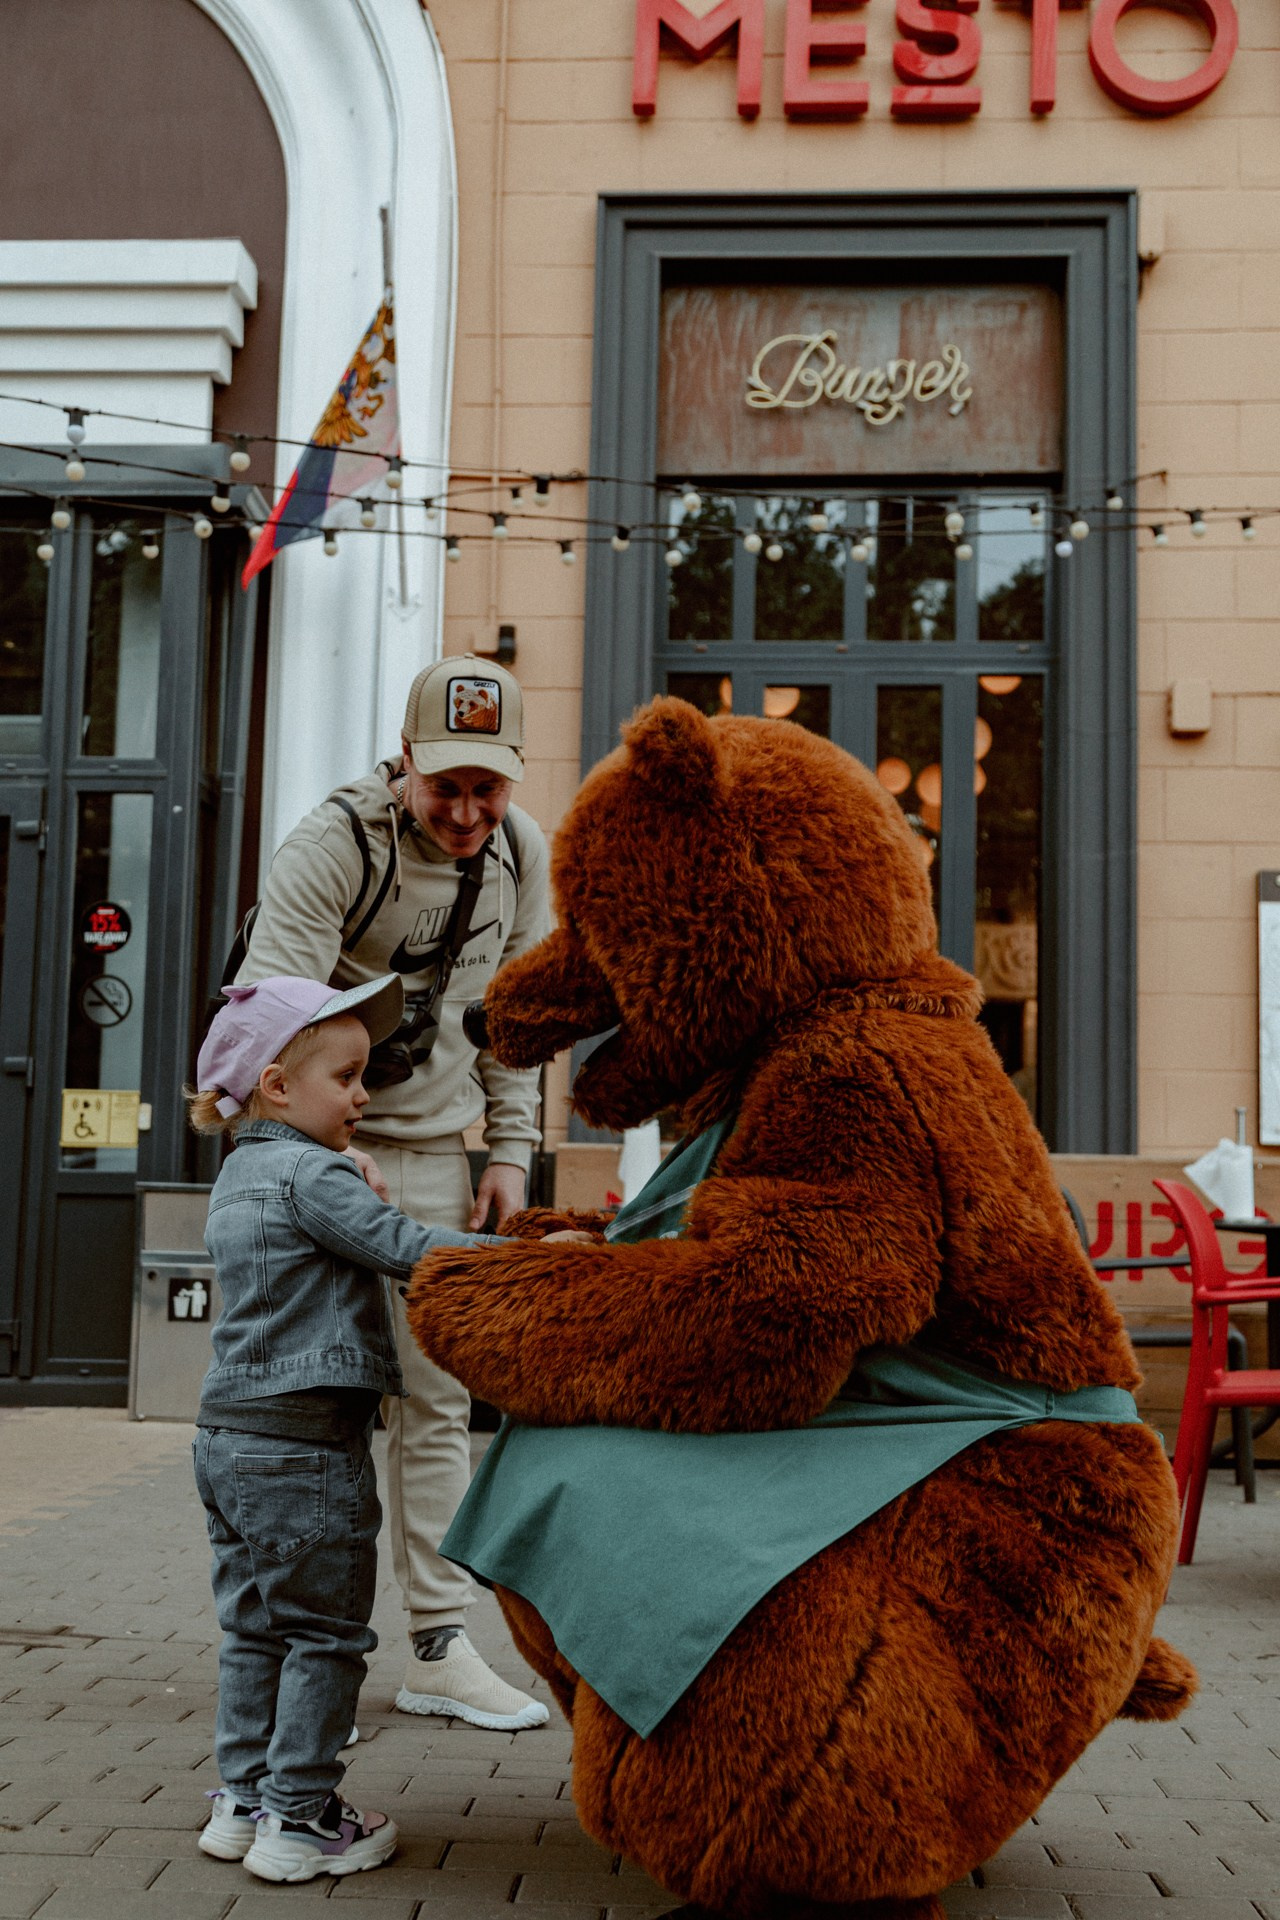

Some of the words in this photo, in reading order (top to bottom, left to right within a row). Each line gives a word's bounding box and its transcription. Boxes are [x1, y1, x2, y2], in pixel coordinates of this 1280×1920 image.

[632, 0, 1239, 117] MESTO
[745, 329, 973, 426] Burger
[408, 904, 455, 947] NI
[454, 957, 466, 969] st
[467, 956, 478, 967] do
